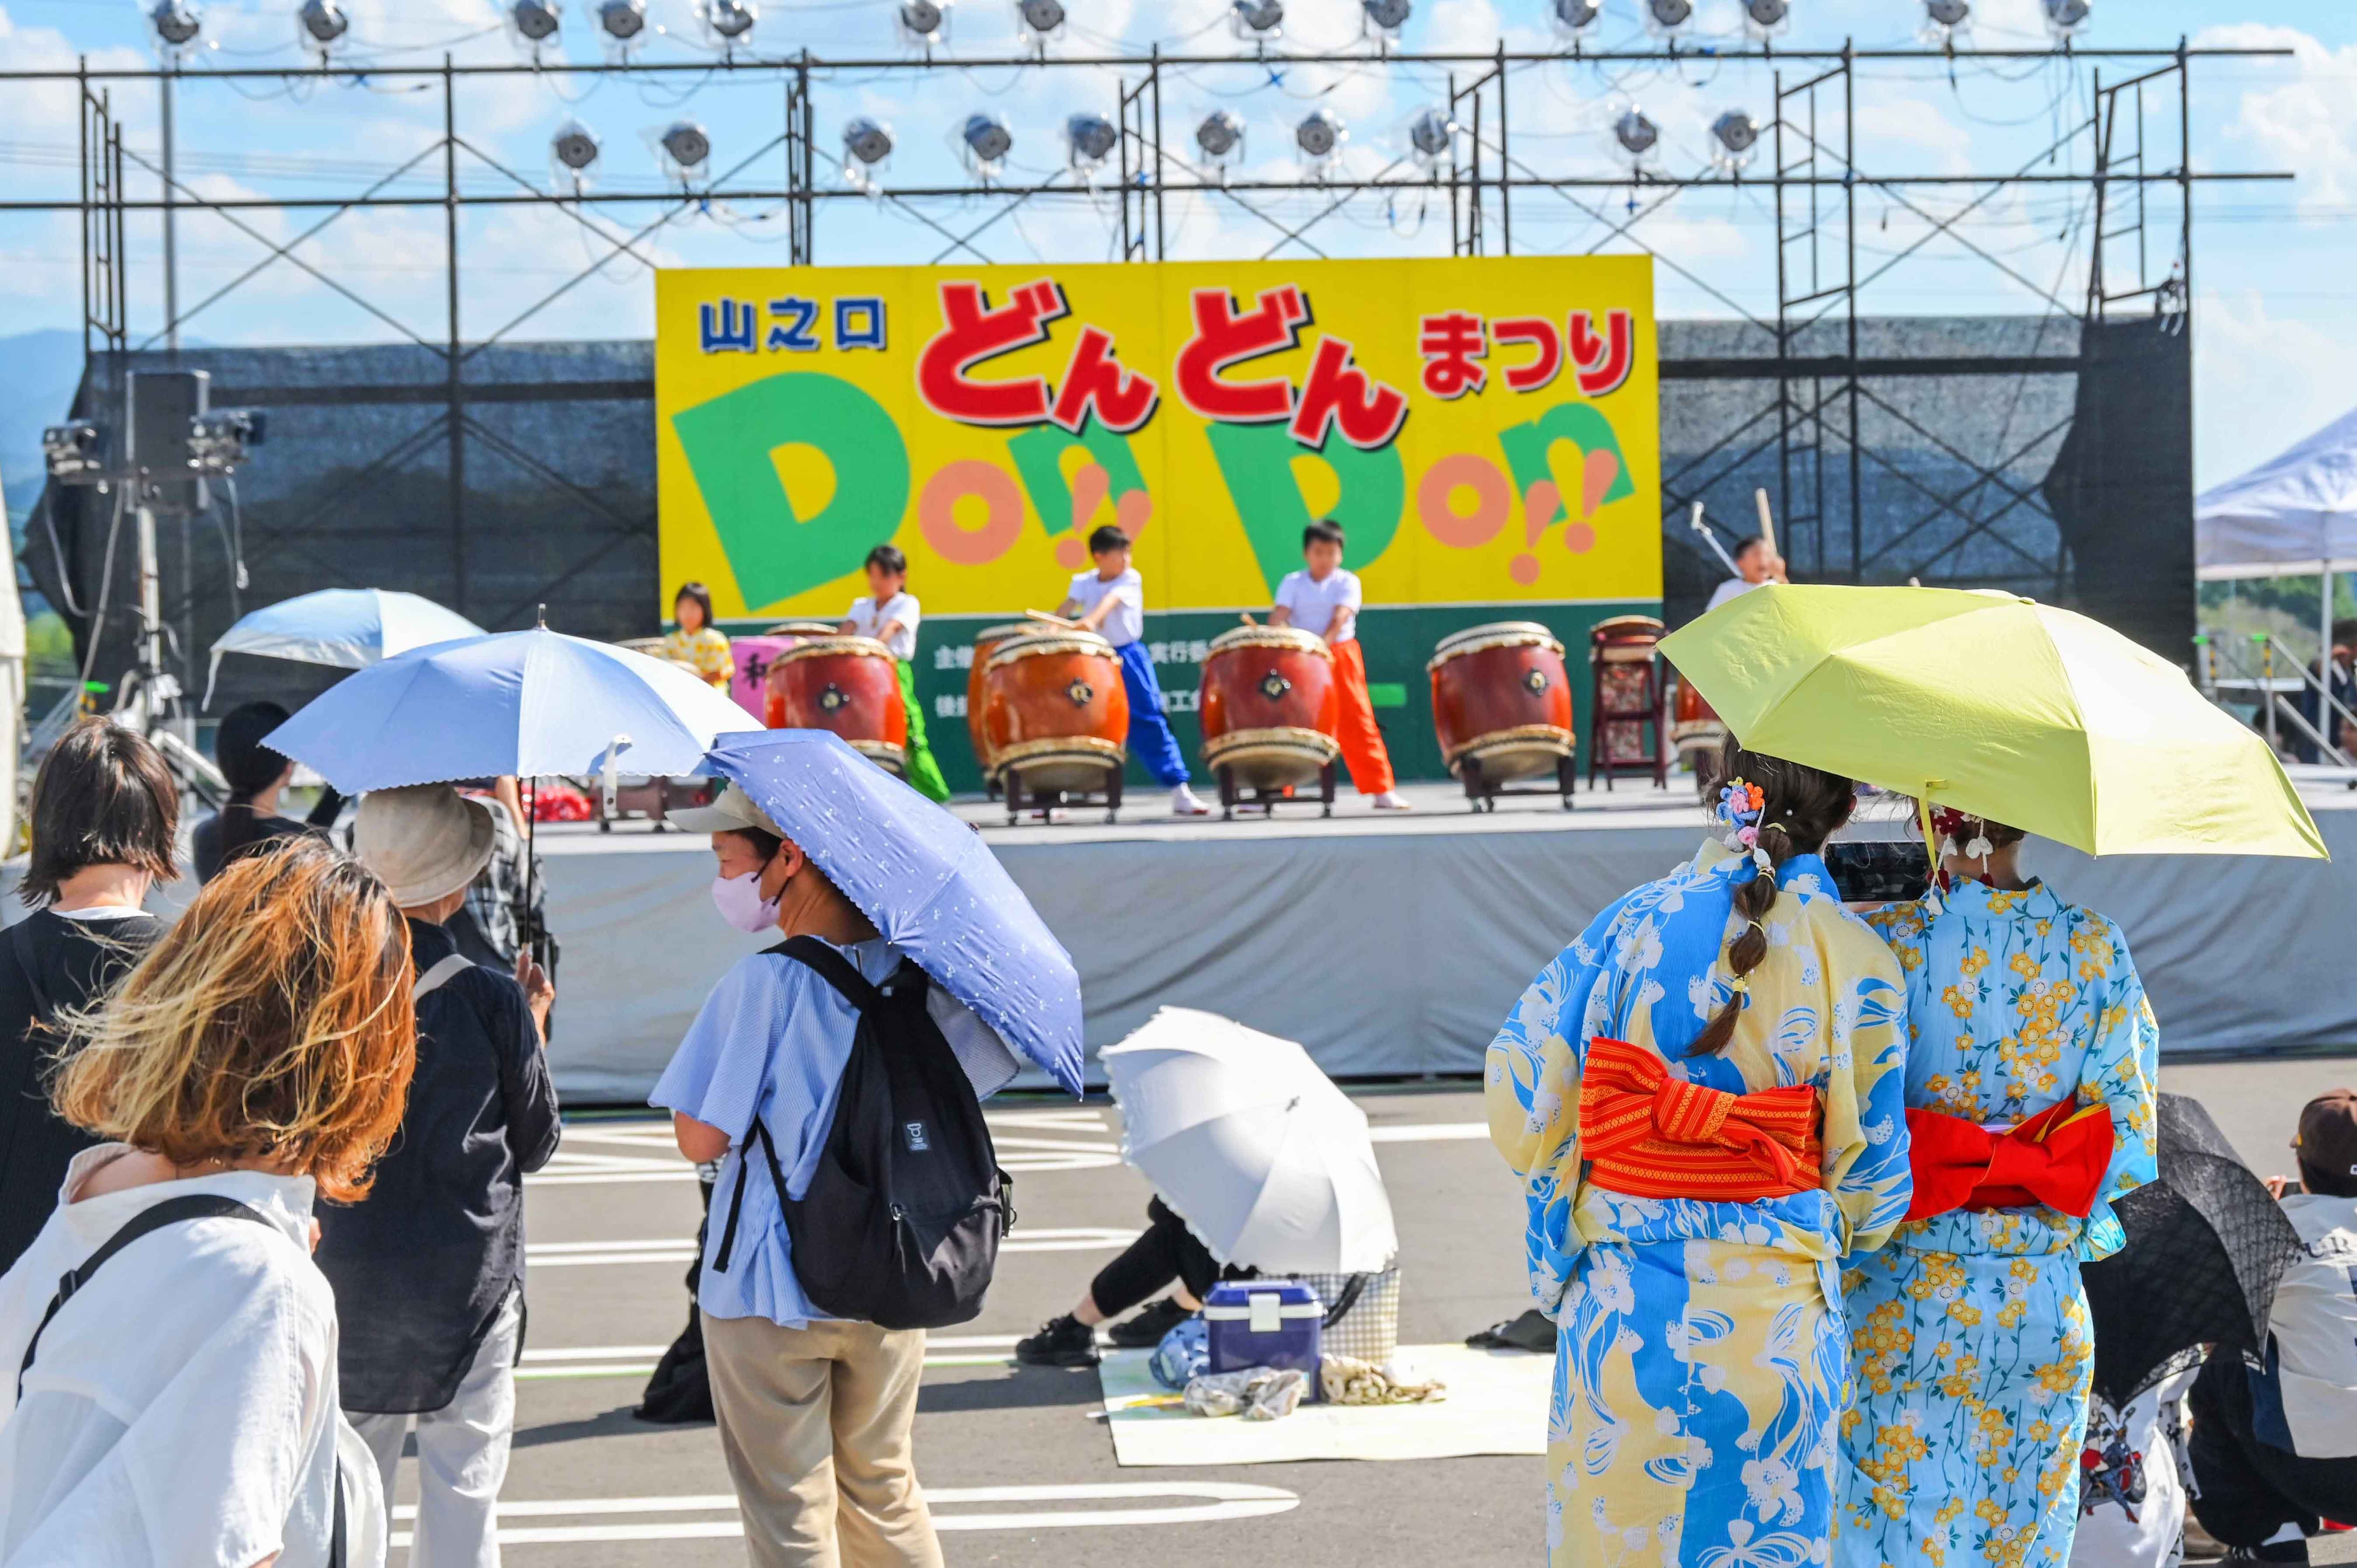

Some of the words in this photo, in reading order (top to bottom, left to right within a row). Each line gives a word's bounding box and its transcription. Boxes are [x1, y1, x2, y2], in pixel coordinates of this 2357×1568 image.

[699, 297, 886, 352] 山之口
[1420, 309, 1633, 399] まつり
